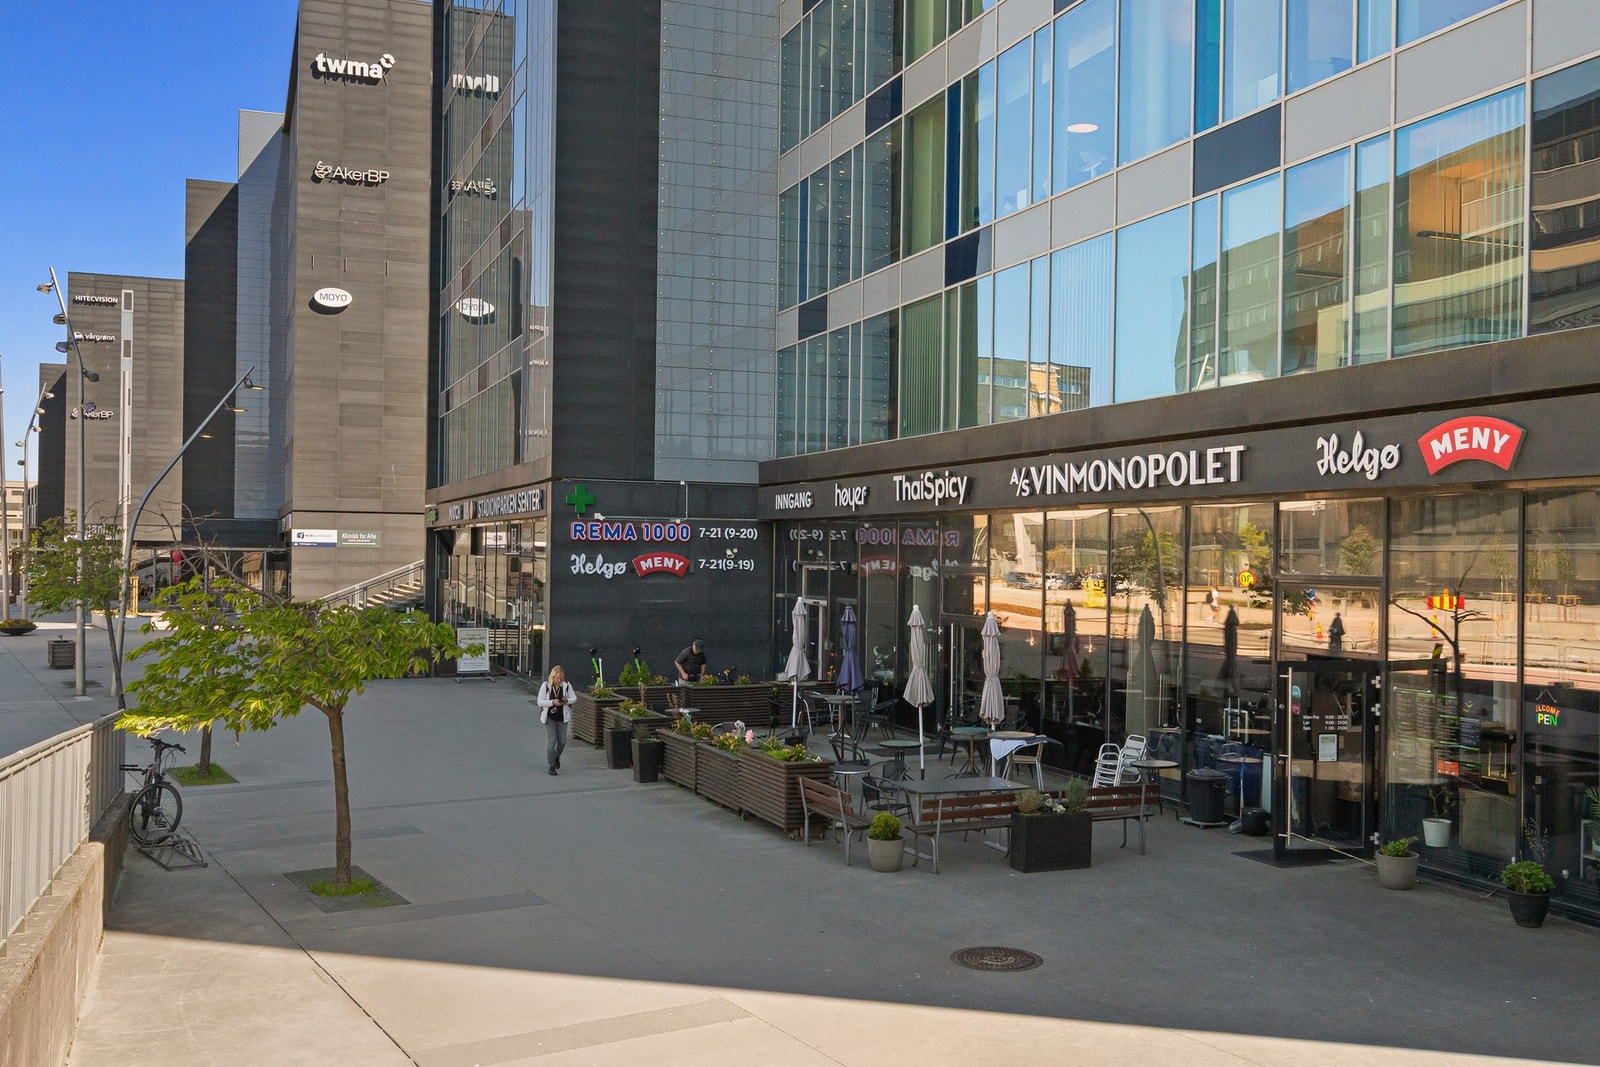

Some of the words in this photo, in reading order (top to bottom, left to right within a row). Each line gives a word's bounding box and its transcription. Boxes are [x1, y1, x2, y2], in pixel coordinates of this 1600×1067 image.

[315, 53, 383, 79] twma
[333, 167, 390, 184] AkerBP
[75, 295, 118, 303] HITECVISION
[319, 292, 348, 302] MOYO
[1317, 431, 1401, 481] Helgø
[1430, 426, 1511, 461] MENY
[1030, 445, 1245, 496] VINMONOPOLET
[517, 488, 540, 513] SENTER
[834, 483, 868, 511] høyer
[893, 470, 969, 506] ThaiSpicy
[775, 492, 812, 510] INNGANG
[570, 521, 637, 542] REMA
[643, 523, 692, 543] 1000
[698, 527, 722, 539] 7-21
[724, 527, 758, 541] (9-20)
[570, 553, 627, 579] Helgø
[640, 556, 685, 573] MENY
[1535, 703, 1561, 717] ELCOME
[1535, 712, 1559, 727] PEN
